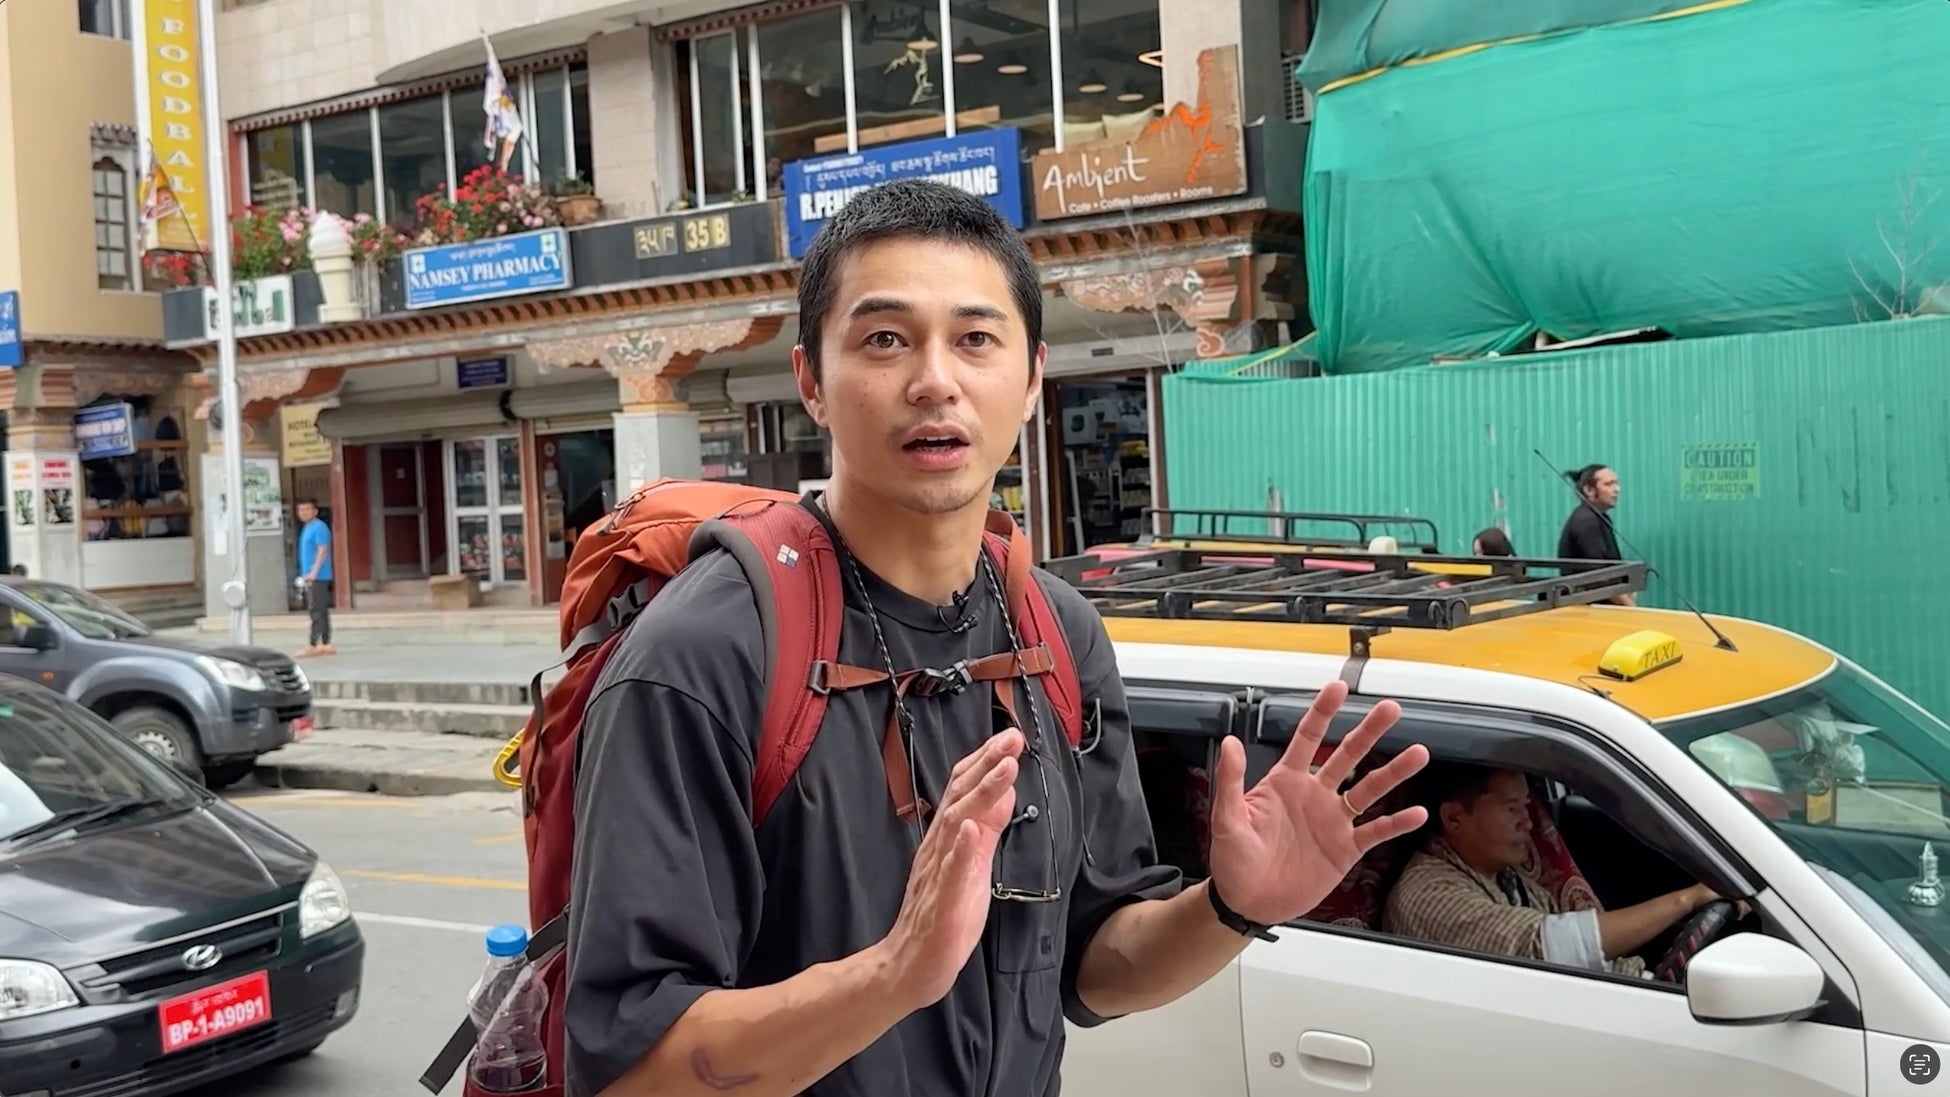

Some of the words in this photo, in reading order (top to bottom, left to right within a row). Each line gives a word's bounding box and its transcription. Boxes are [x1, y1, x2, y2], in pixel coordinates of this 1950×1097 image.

[1043, 146, 1150, 214] Ambient
[801, 184, 872, 220] R.PEN
[1101, 198, 1131, 209] Coffee
[1132, 192, 1172, 205] Roasters
[1180, 186, 1213, 198] Rooms
[686, 219, 710, 249] 35
[714, 216, 727, 246] B
[409, 265, 471, 290] NAMSEY
[472, 250, 563, 282] PHARMACY
[1686, 451, 1752, 467] CAUTION
[1644, 640, 1676, 669] TAXI
[168, 995, 265, 1046] BP-1-A9091
